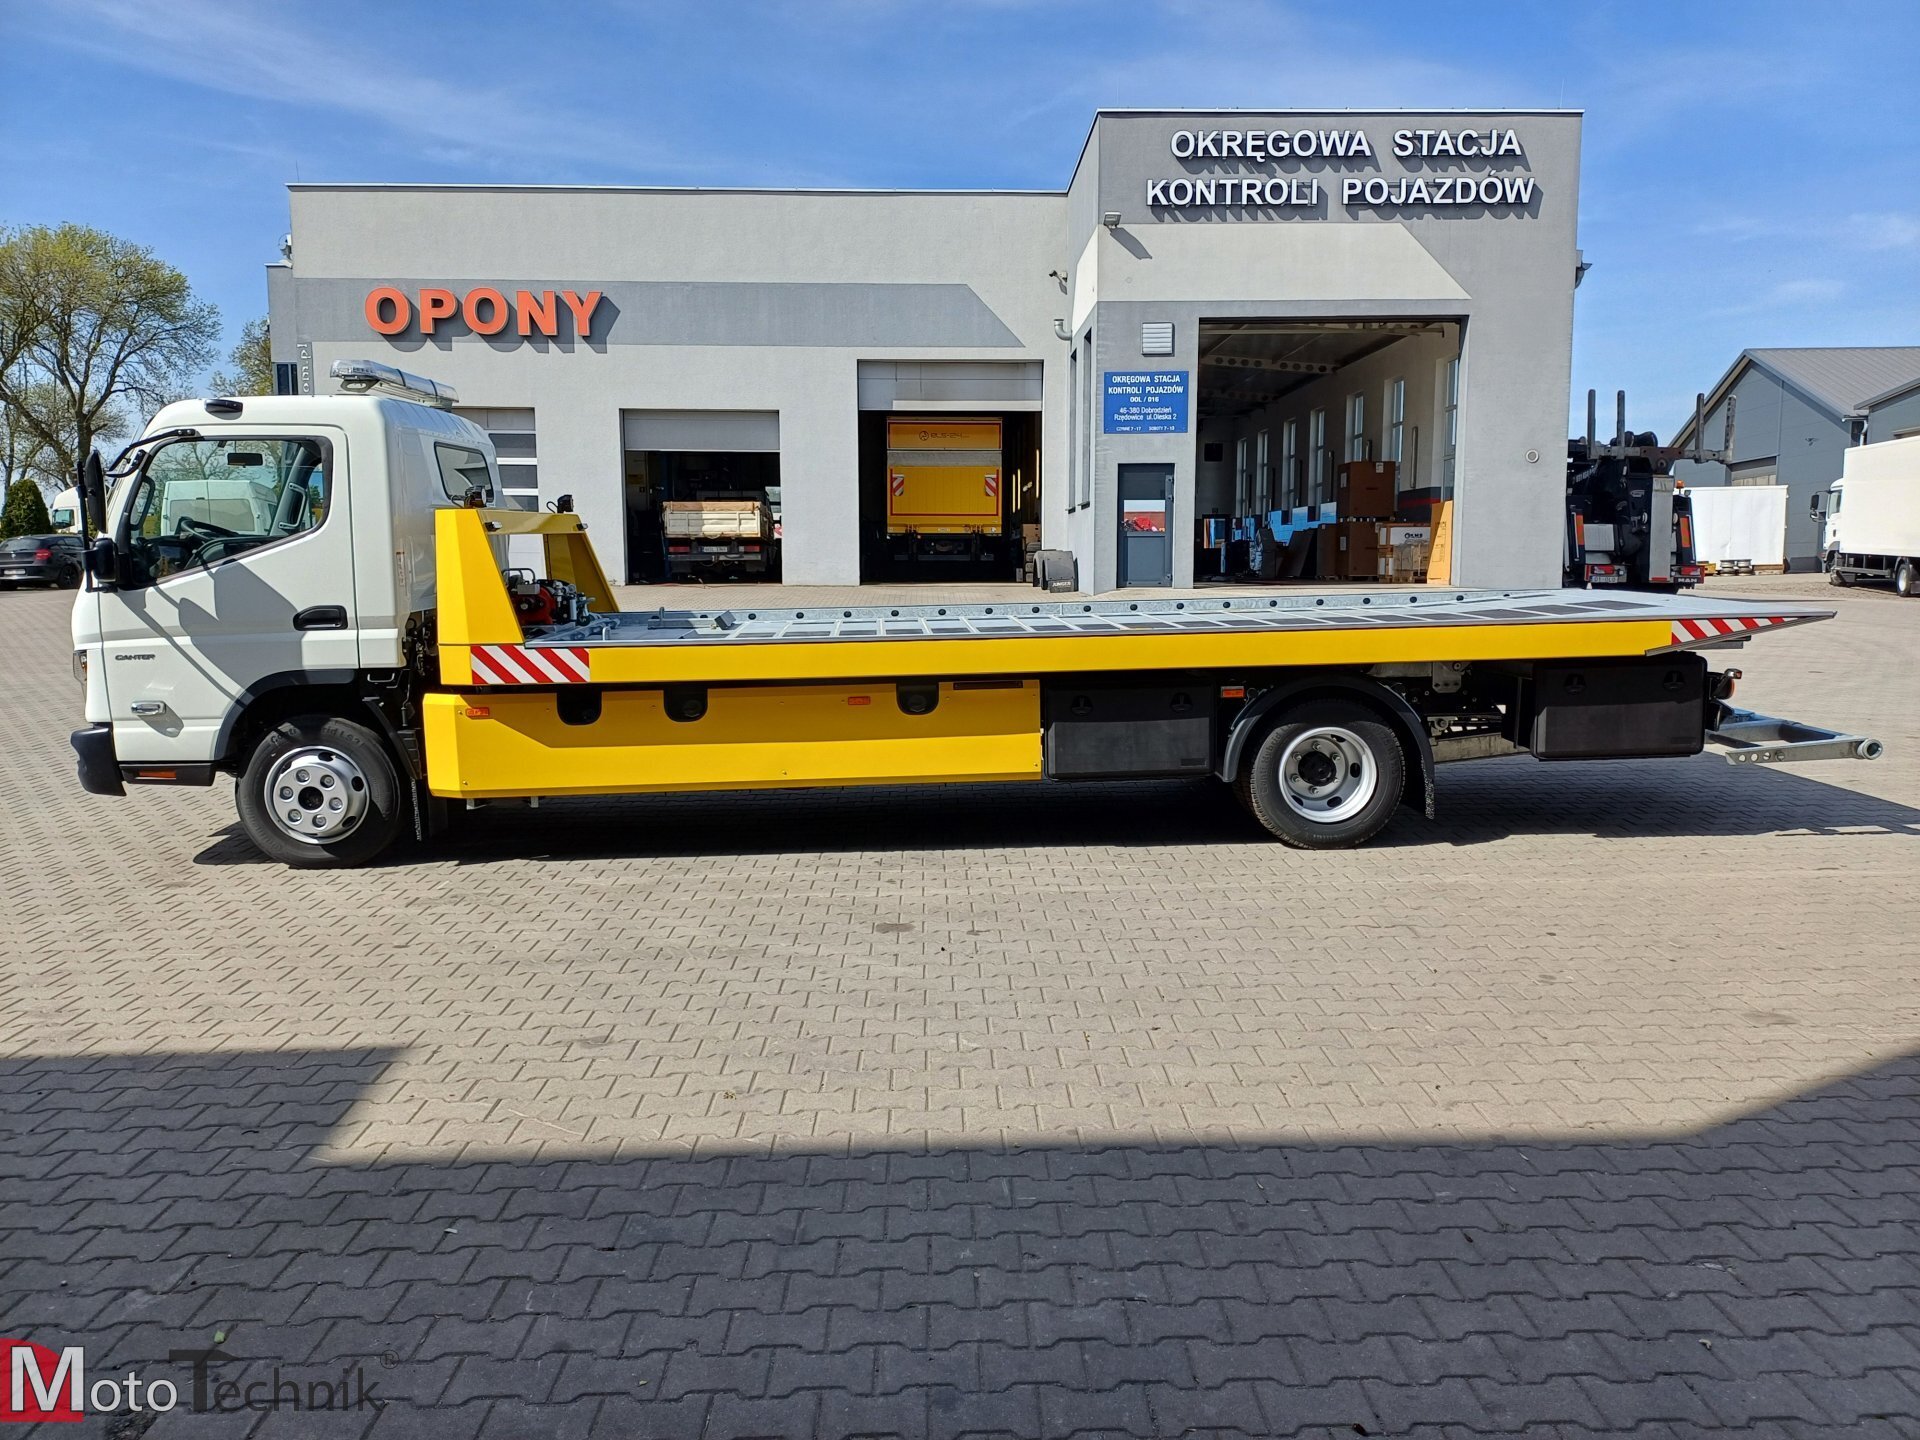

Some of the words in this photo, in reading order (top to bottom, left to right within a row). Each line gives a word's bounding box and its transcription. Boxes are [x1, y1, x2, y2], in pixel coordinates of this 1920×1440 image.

[1169, 129, 1371, 163] OKRĘGOWA
[1392, 129, 1522, 157] STACJA
[1146, 178, 1318, 207] KONTROLI
[1342, 170, 1535, 205] POJAZDÓW
[364, 286, 603, 338] OPONY
[1112, 376, 1150, 384] OKRĘGOWA
[1146, 385, 1184, 394] POJAZDÓW
